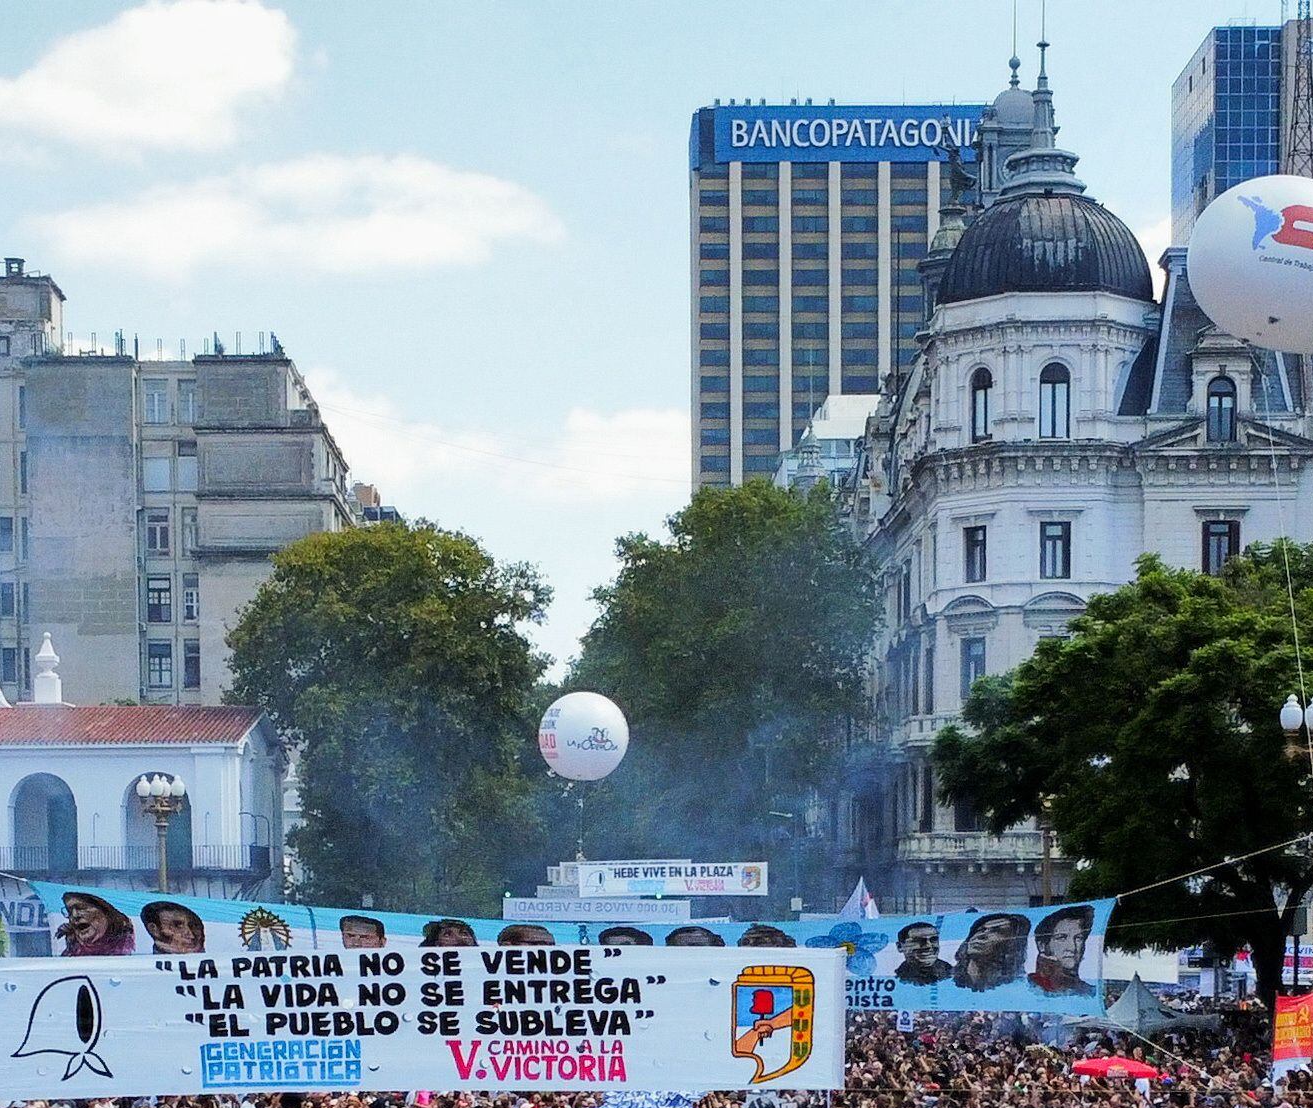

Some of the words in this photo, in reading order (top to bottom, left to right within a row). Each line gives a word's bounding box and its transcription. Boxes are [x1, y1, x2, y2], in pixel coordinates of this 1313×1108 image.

[1258, 254, 1283, 267] Central
[643, 866, 666, 879] VIVE
[669, 866, 682, 878] EN
[685, 866, 698, 878] LA
[232, 953, 345, 979] PATRIA
[359, 951, 406, 977] NO
[420, 950, 462, 978] SE
[260, 984, 340, 1008] VIDA
[358, 982, 407, 1008] NO
[421, 981, 465, 1008] SE
[266, 1012, 400, 1038] PUEBLO
[417, 1011, 461, 1037] SE
[205, 1039, 362, 1062] GENERACIÓN
[488, 1039, 569, 1057] CAMINO
[577, 1039, 593, 1056] A
[600, 1039, 624, 1056] LA
[208, 1059, 362, 1081] PATRIÓTICA
[487, 1055, 628, 1083] VICTORIA
